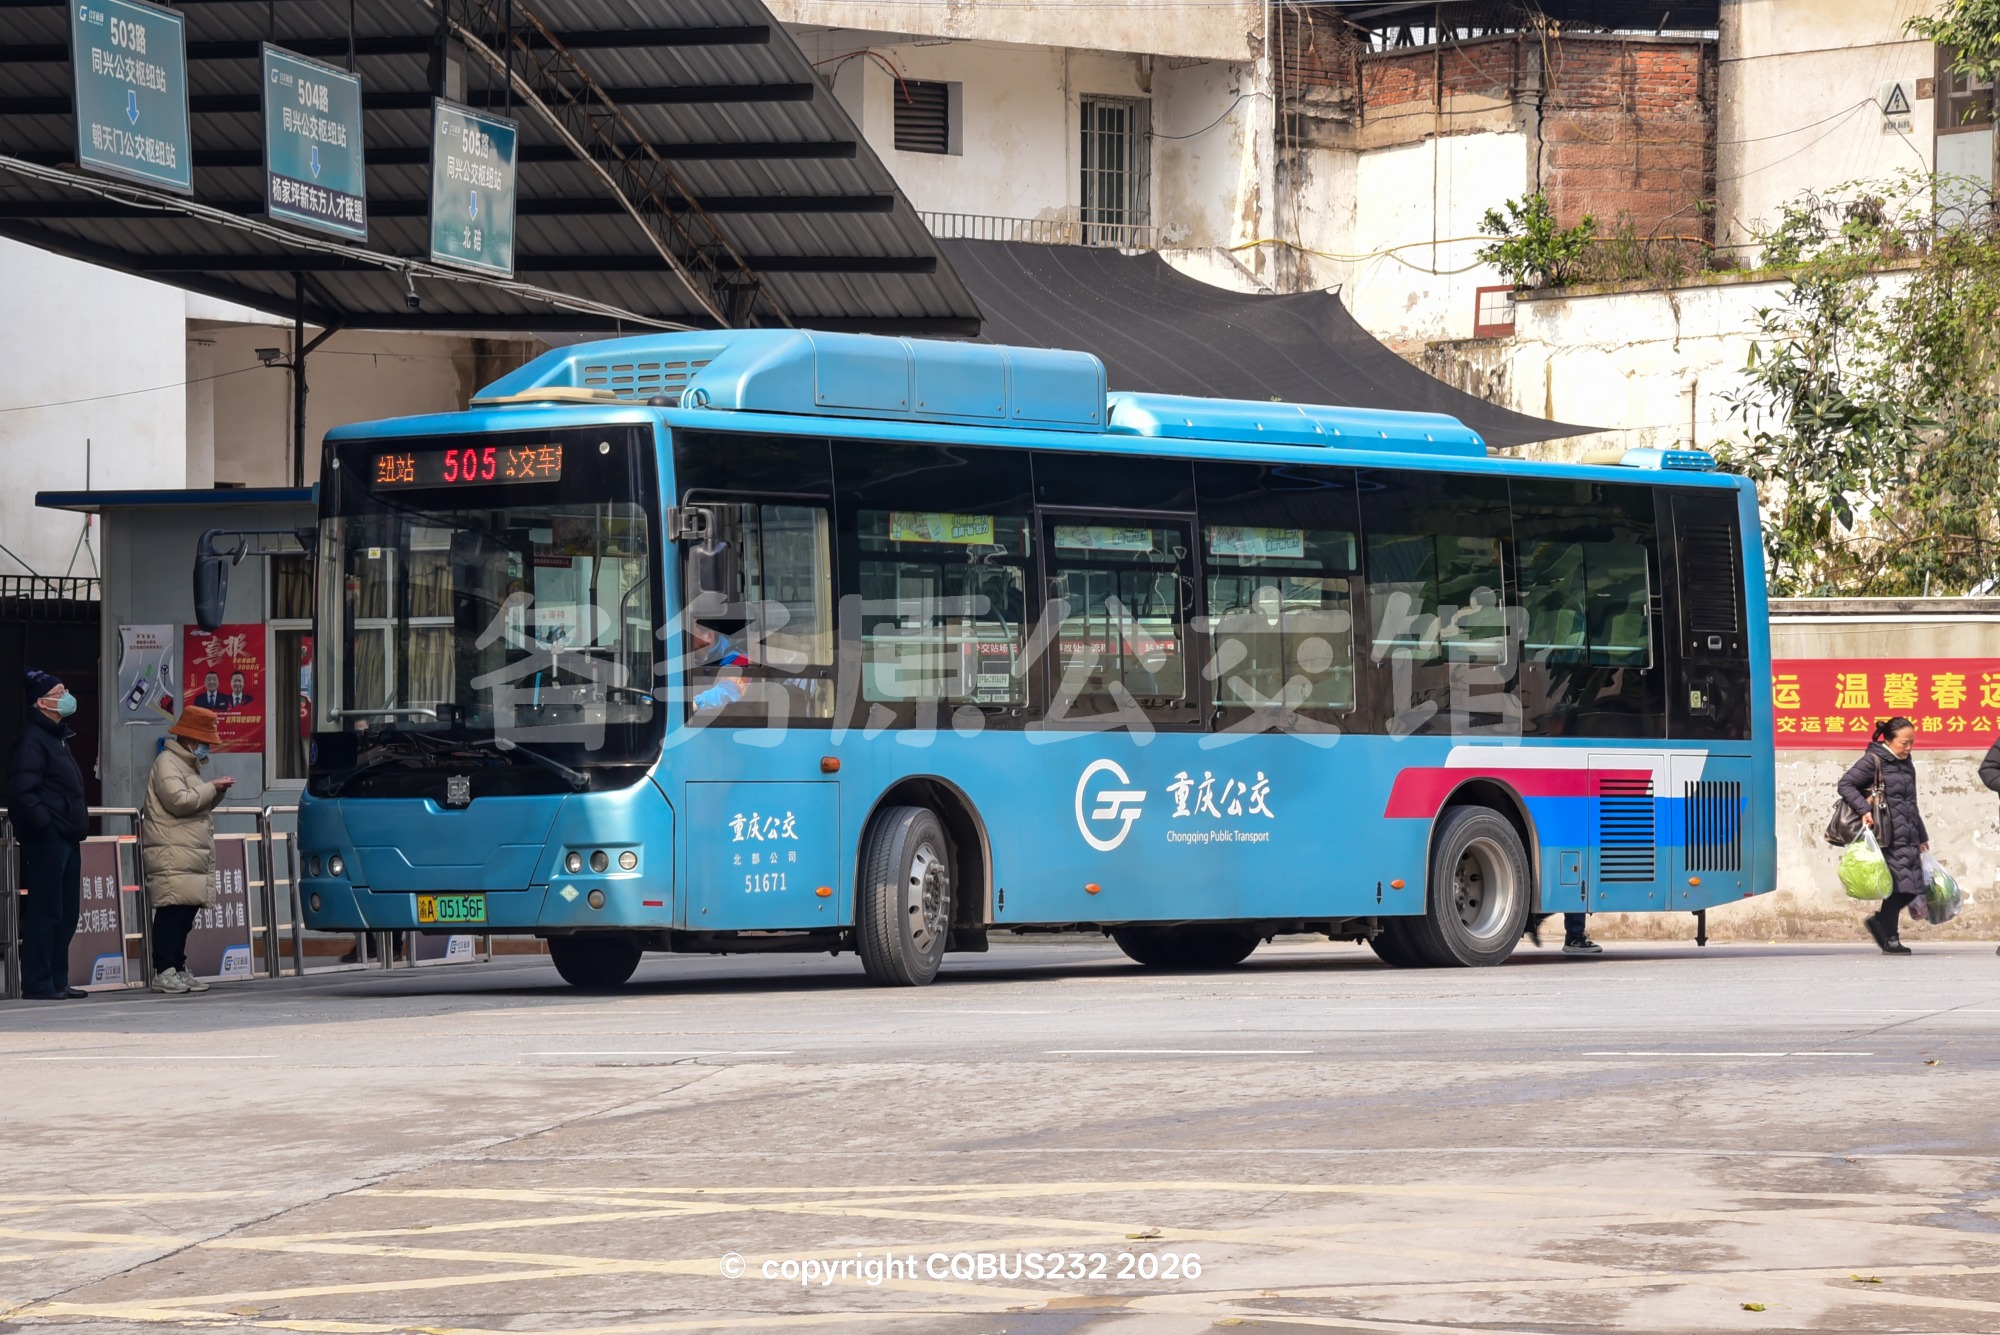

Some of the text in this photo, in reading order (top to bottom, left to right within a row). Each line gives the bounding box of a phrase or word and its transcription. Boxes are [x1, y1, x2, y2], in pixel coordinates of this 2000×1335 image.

[110, 16, 146, 55] 503路
[91, 47, 167, 93] 同兴公交枢纽站
[298, 78, 329, 113] 504路
[282, 106, 347, 148] 同兴公交枢纽站
[462, 128, 490, 159] 505路
[91, 122, 176, 169] 朝天门公交枢纽站
[446, 155, 502, 191] 同兴公交枢纽站
[272, 175, 363, 224] 杨家坪新东方人才联盟
[443, 448, 496, 482] 505
[192, 633, 252, 668] 喜报
[1772, 674, 1800, 709] 运
[1166, 771, 1274, 818] 重庆公交
[728, 811, 798, 842] 重庆公交
[1167, 831, 1269, 844] Chongqing Public Transport
[733, 851, 796, 865] 北部公司
[745, 872, 787, 893] 51671
